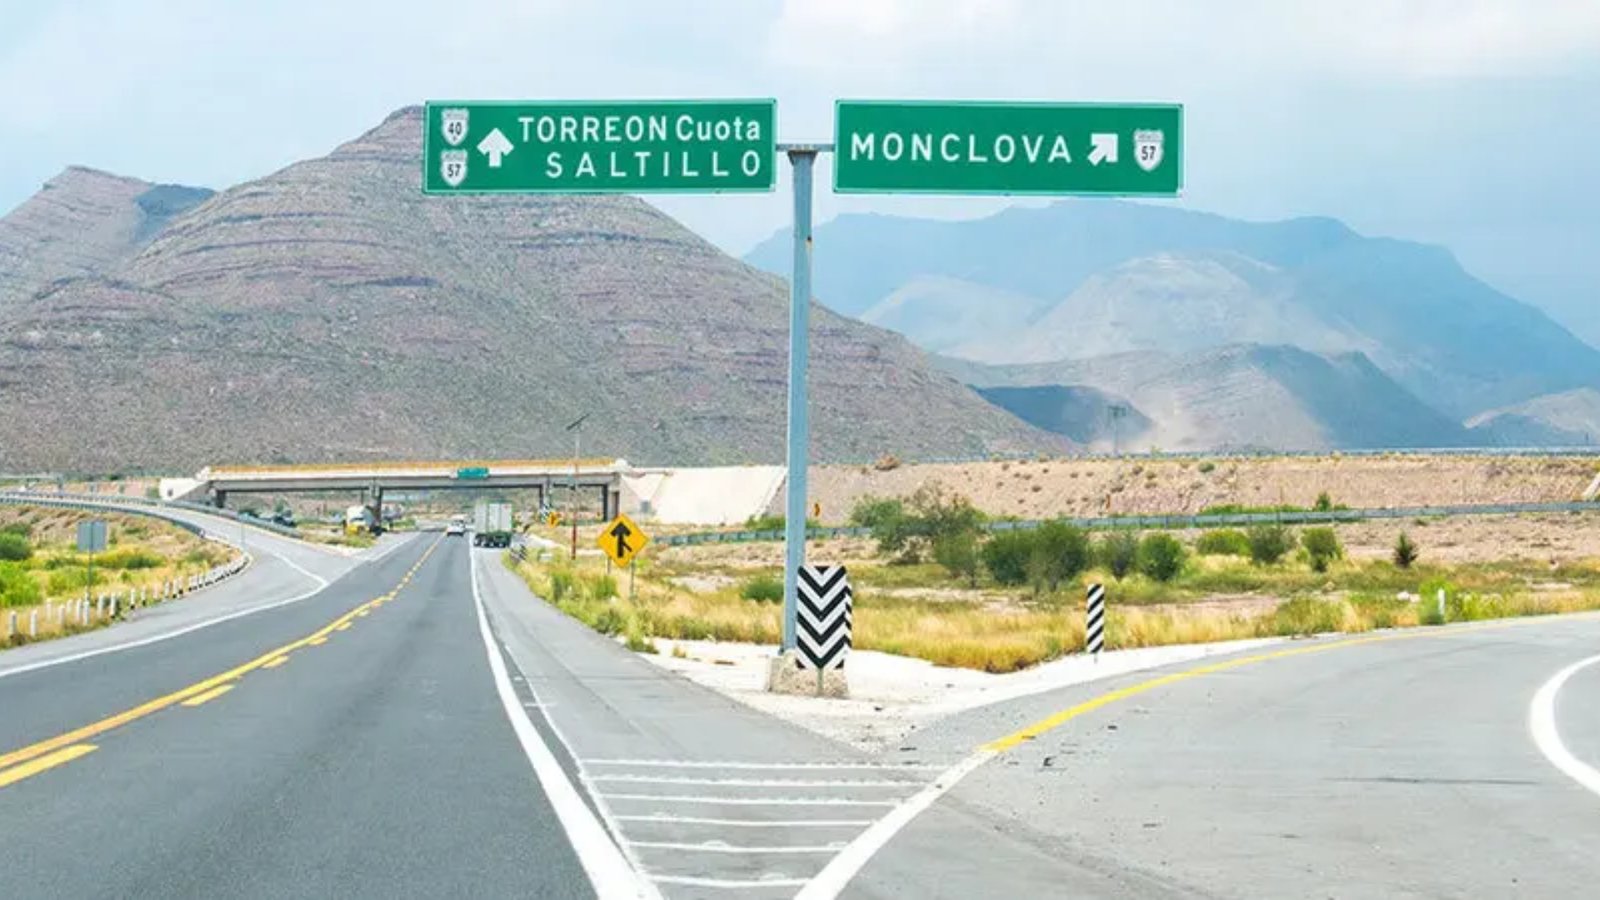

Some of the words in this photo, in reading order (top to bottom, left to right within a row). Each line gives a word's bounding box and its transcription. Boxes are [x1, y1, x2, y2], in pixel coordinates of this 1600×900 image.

[447, 121, 462, 136] 40
[518, 115, 667, 142] TORREON
[676, 114, 760, 141] Cuota
[851, 132, 1071, 163] MONCLOVA
[1141, 145, 1157, 162] 57
[447, 163, 462, 179] 57
[546, 151, 760, 178] SALTILLO
